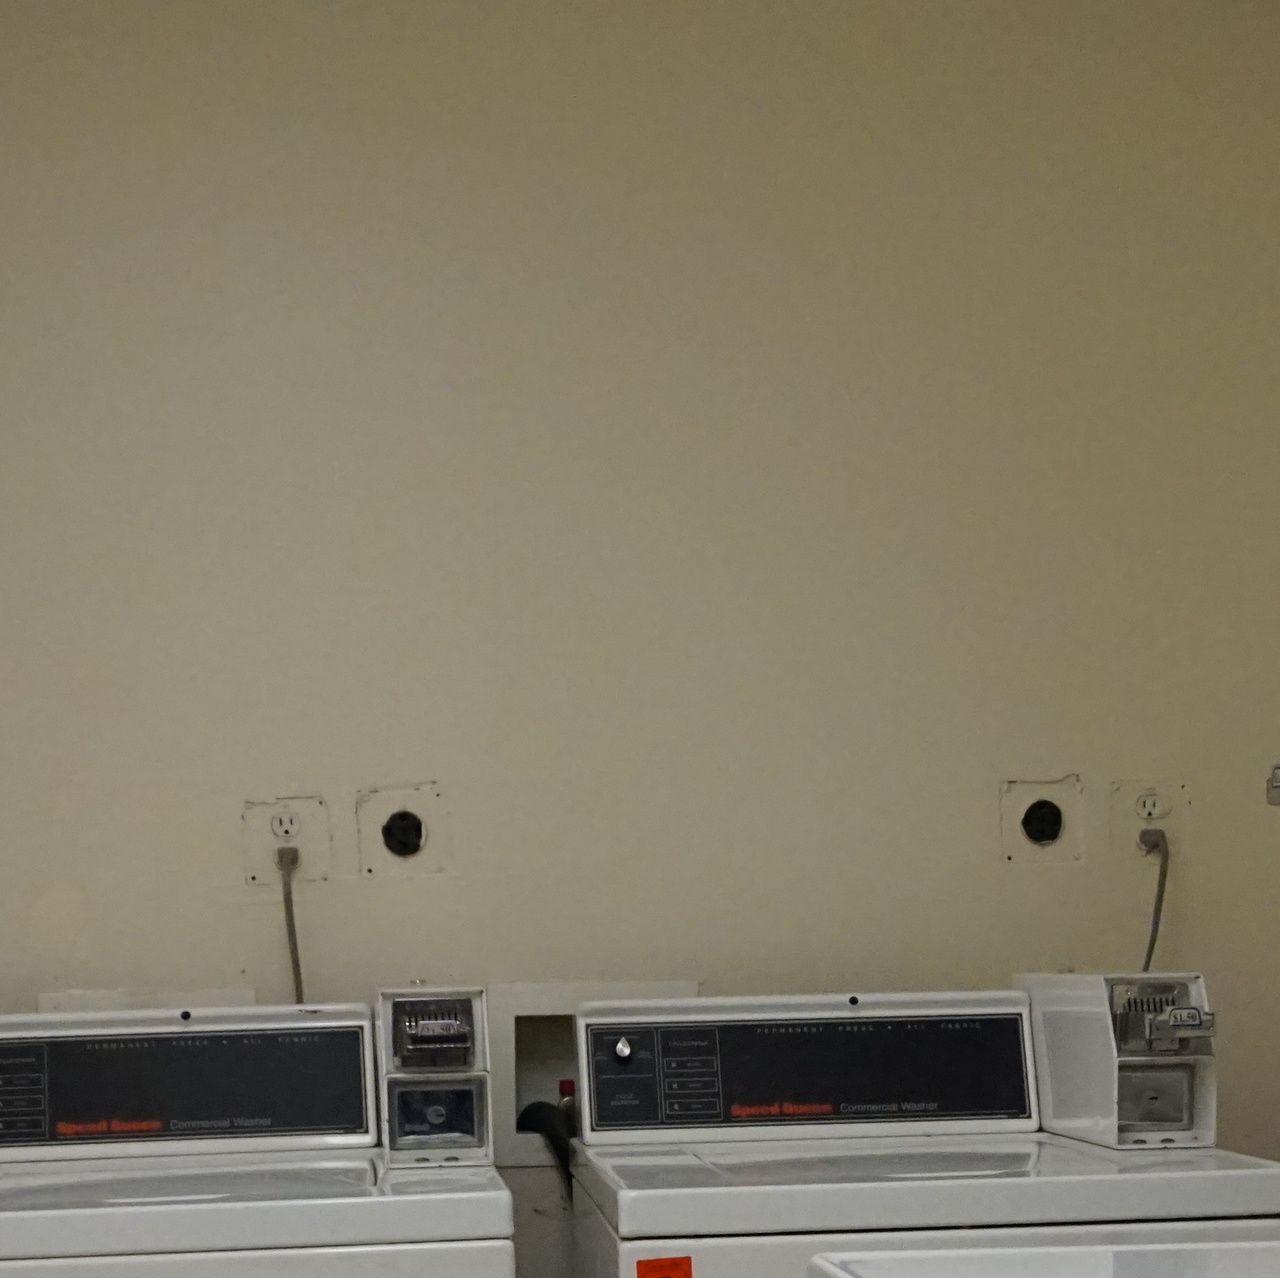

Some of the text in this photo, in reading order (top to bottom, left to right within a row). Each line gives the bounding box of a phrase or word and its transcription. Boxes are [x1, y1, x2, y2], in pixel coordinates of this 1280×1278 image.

[1173, 1012, 1198, 1023] $1.50
[840, 1102, 899, 1112] Commercial
[901, 1101, 939, 1111] Washer
[170, 1118, 231, 1130] Commercial
[233, 1117, 273, 1128] Washer
